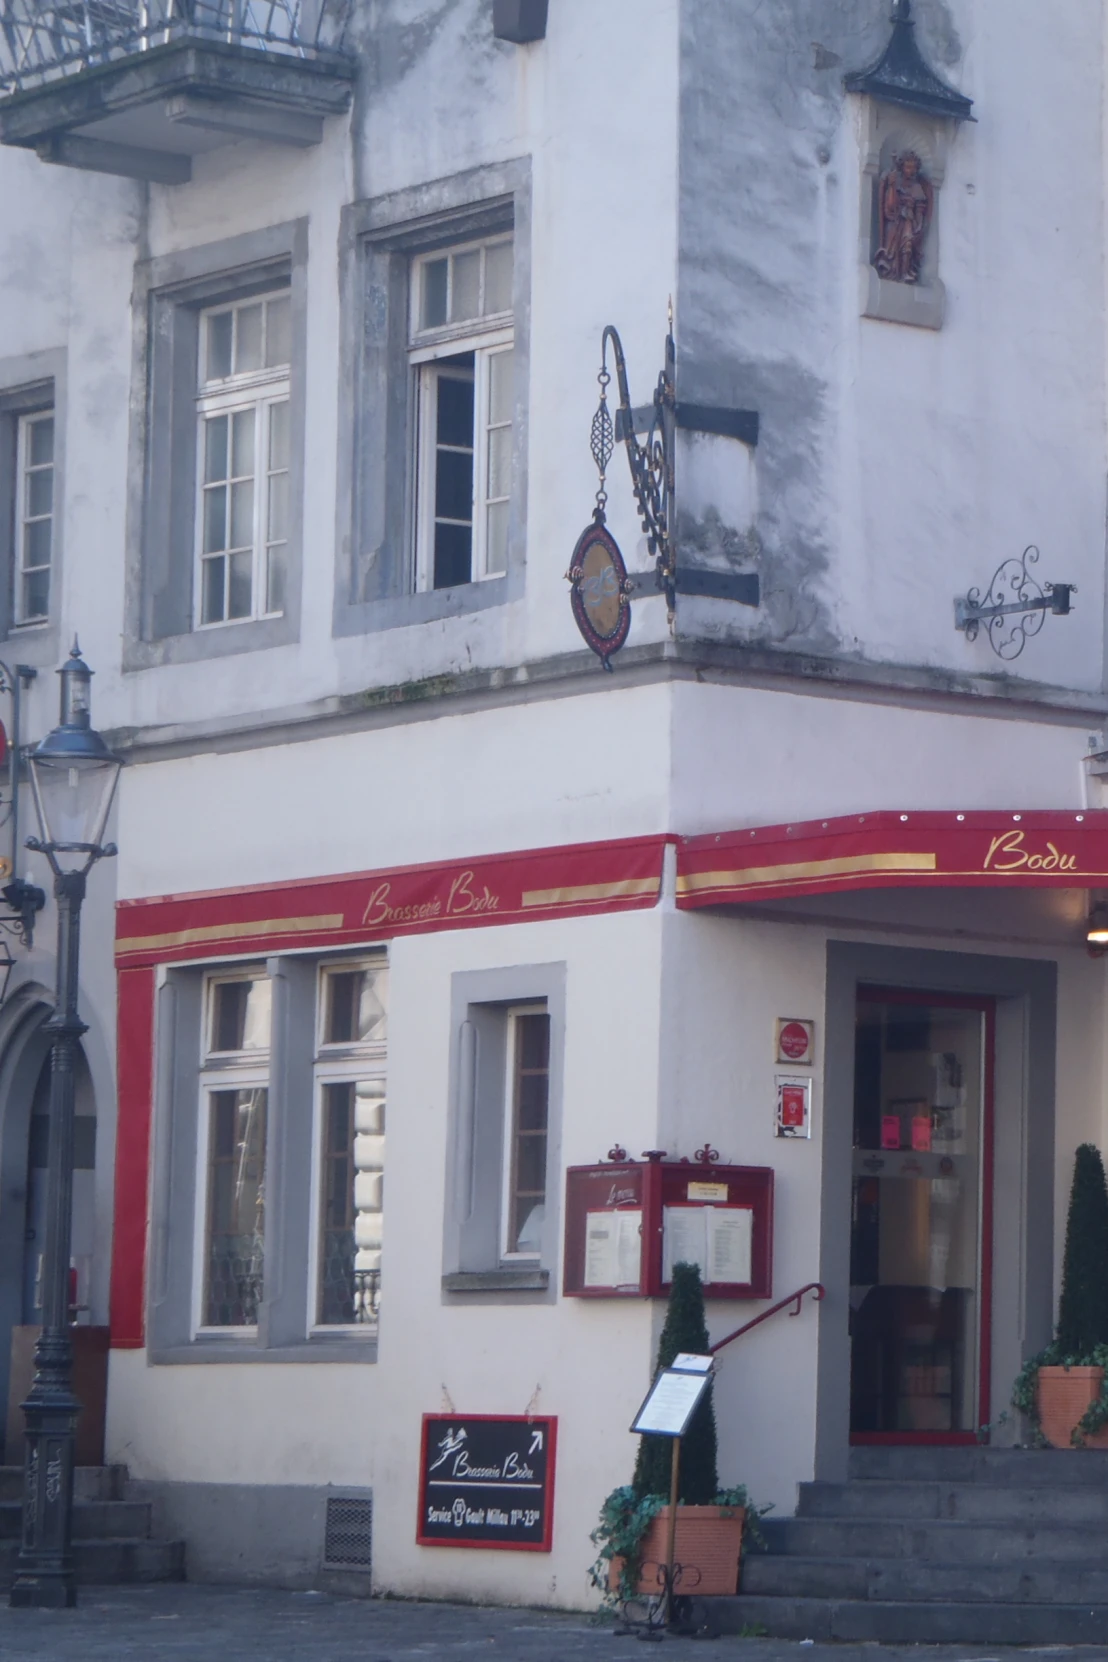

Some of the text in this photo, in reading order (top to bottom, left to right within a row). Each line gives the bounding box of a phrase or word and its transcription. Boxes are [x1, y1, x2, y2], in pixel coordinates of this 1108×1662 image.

[983, 829, 1077, 870] Bodu
[362, 870, 500, 925] Brasserie Bodu
[452, 1451, 500, 1478] Brasserie
[428, 1506, 452, 1524] Service
